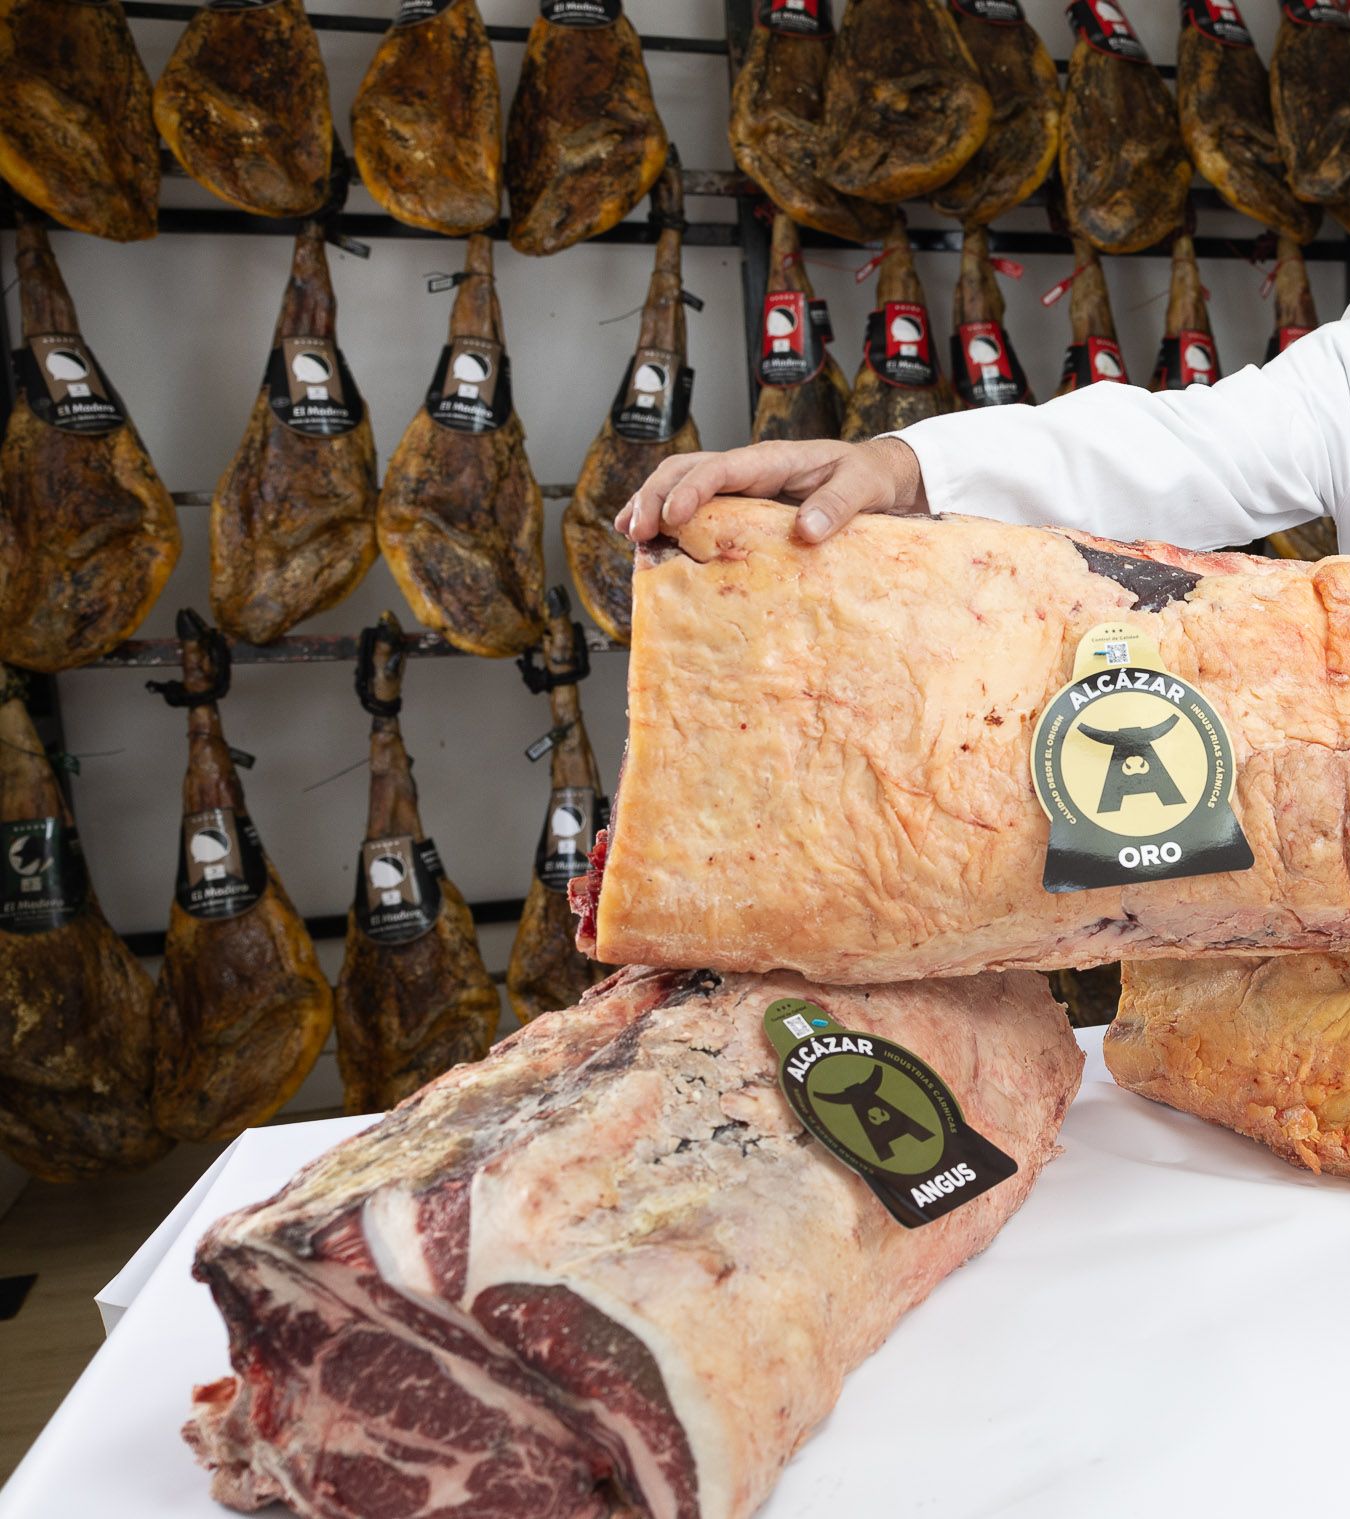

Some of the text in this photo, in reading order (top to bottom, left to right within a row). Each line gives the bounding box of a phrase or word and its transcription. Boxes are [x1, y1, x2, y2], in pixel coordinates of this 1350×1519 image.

[1068, 667, 1186, 711] ALCÁZAR
[1045, 714, 1077, 825] CALIDAD DESDE EL ORIGEN
[1190, 703, 1225, 809] INDUSTRIAS CÁRNICAS
[1118, 841, 1183, 869] ORO
[786, 1037, 874, 1083] ALCÁZAR
[884, 1050, 935, 1089] INDUSTRIAS
[910, 1162, 977, 1208] ANGUS
